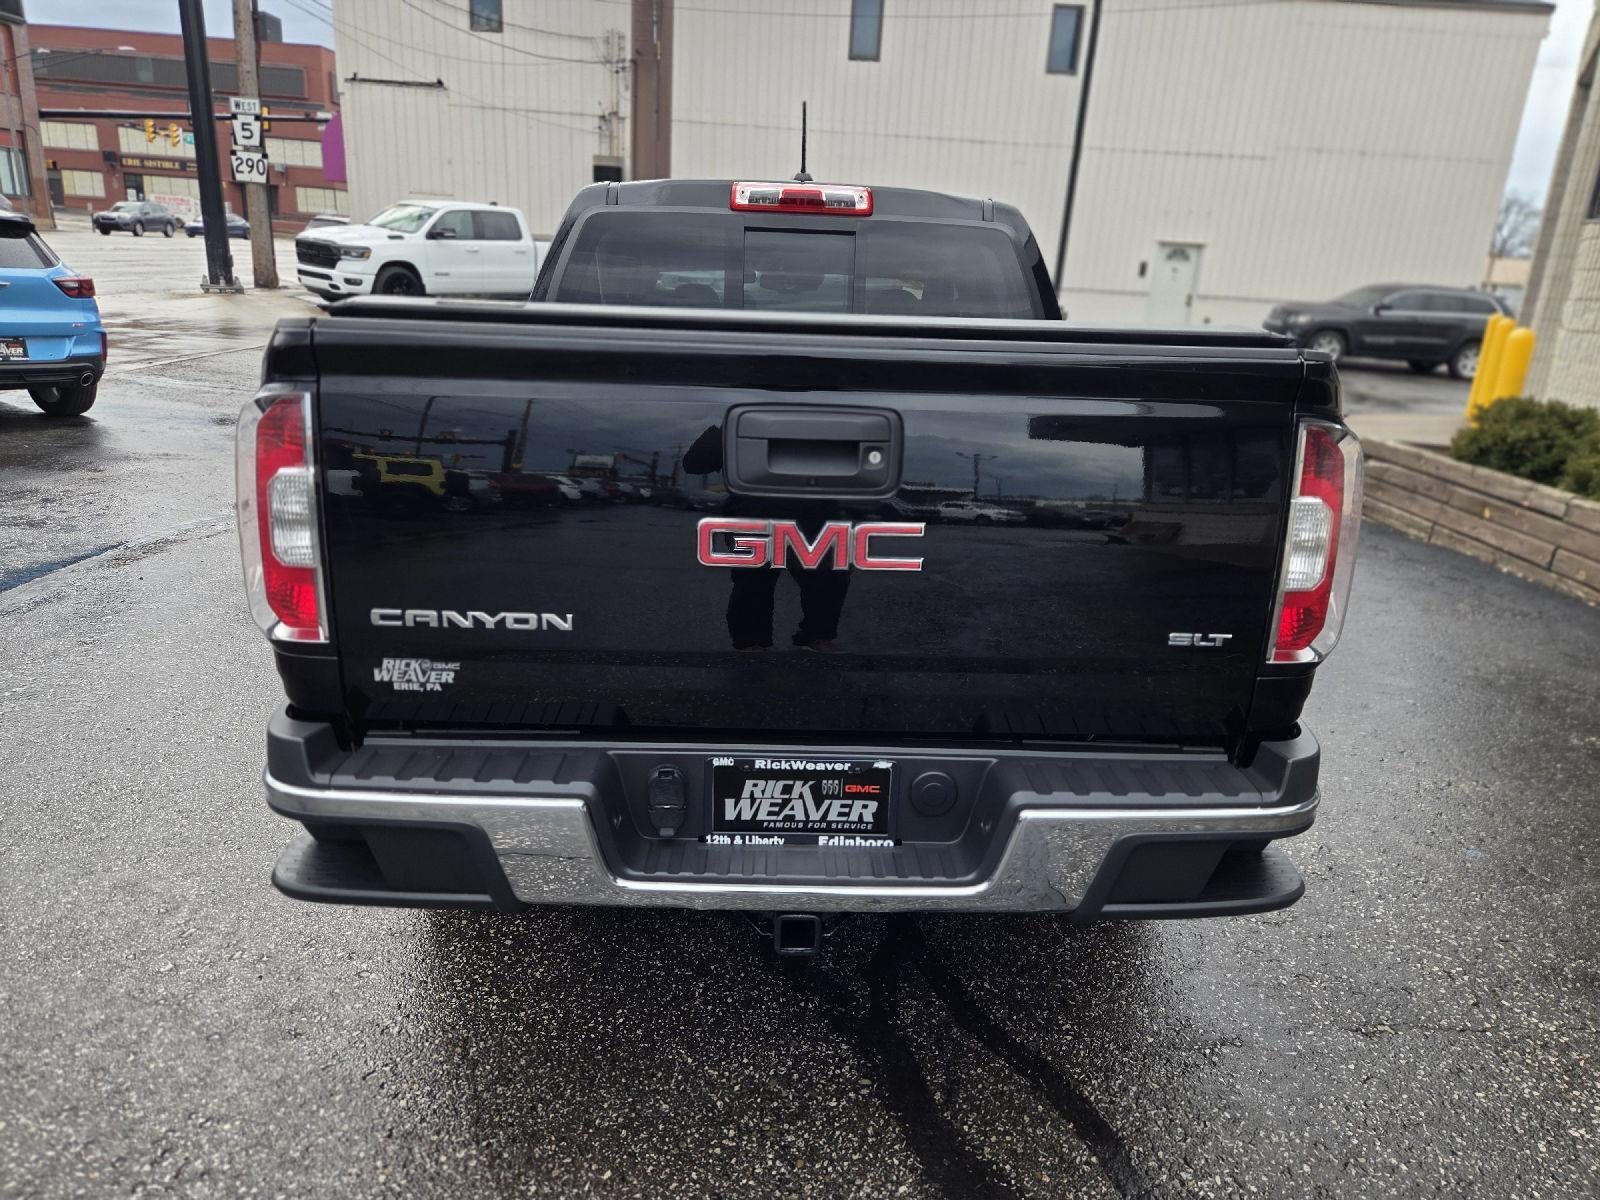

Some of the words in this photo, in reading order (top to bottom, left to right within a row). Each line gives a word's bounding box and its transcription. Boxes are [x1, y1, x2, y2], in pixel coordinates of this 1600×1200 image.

[234, 101, 257, 111] WEST
[241, 122, 254, 139] 5
[235, 156, 266, 176] 290
[697, 517, 926, 571] GMC
[370, 608, 573, 631] CANYON
[1168, 632, 1233, 647] SLT
[382, 658, 422, 670] RICK
[432, 662, 460, 670] GMC
[374, 668, 455, 683] WEAVER
[394, 682, 424, 692] ERIE,
[426, 683, 442, 692] PA
[712, 757, 735, 767] GMC
[754, 759, 851, 771] RickWeaver
[741, 779, 817, 799] RICK
[845, 784, 881, 793] GMC
[724, 798, 879, 823] WEAVER
[763, 821, 804, 829] FAMOUS
[808, 821, 827, 830] FOR
[831, 822, 873, 830] SERVICE
[705, 834, 732, 846] 12th
[733, 835, 743, 845] &
